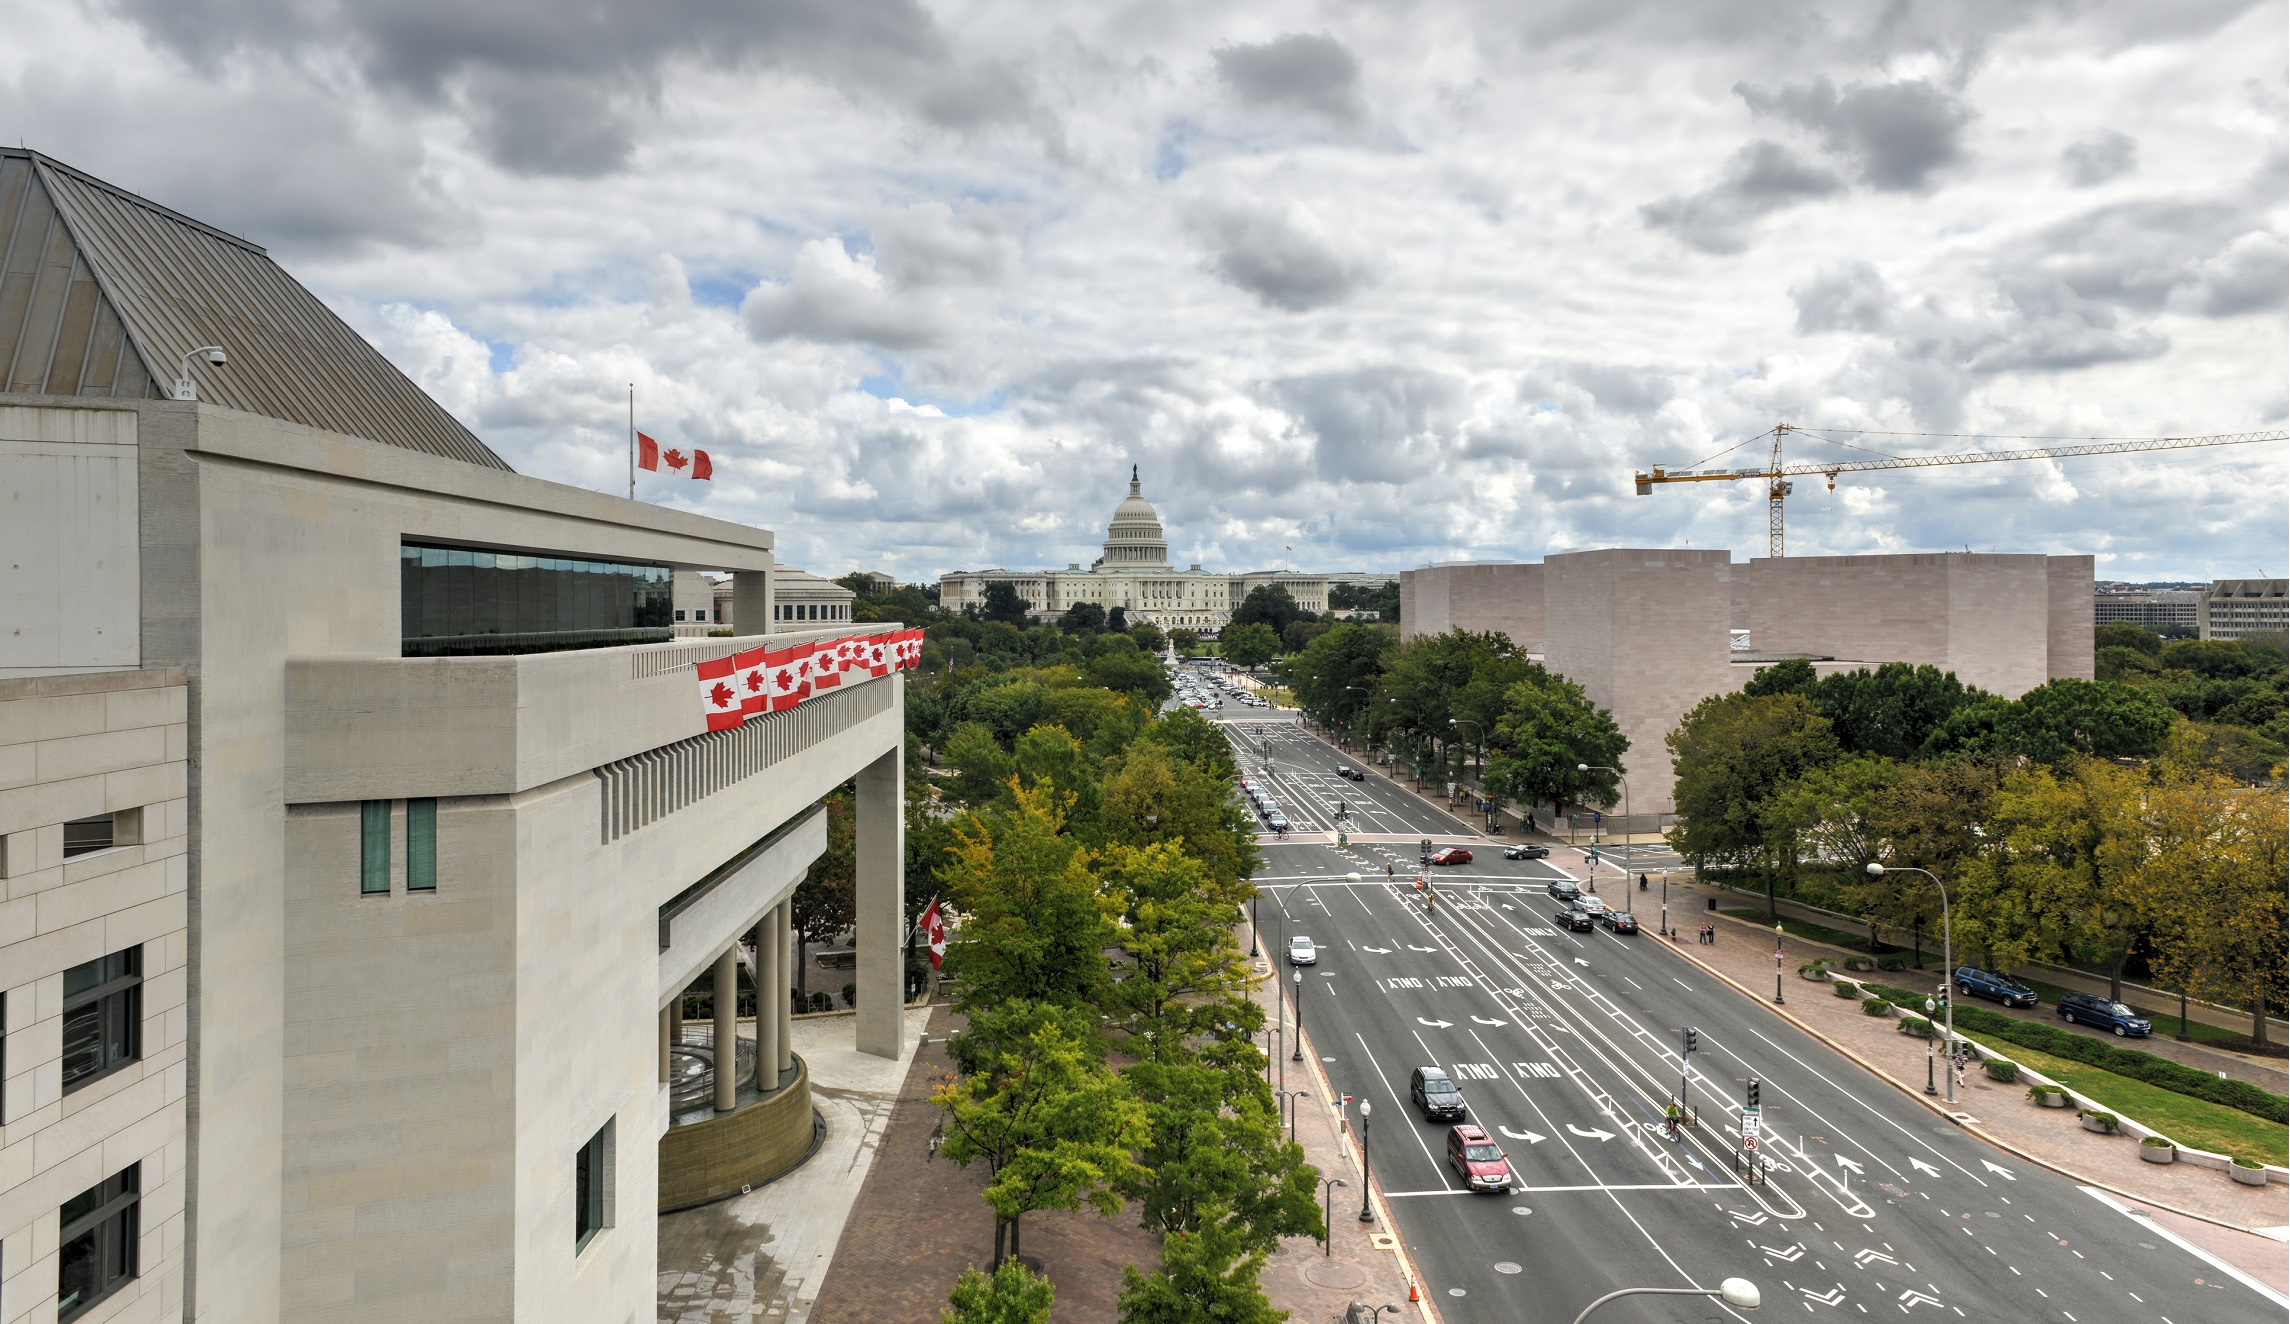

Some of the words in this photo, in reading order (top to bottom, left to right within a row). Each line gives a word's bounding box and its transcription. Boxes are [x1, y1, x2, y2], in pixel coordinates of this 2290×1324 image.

[1523, 928, 1558, 936] ONLY
[1387, 978, 1423, 988] ONLY
[1436, 976, 1473, 987] ONLY
[1452, 1063, 1499, 1080] ONLY
[1512, 1062, 1562, 1078] ONLY
